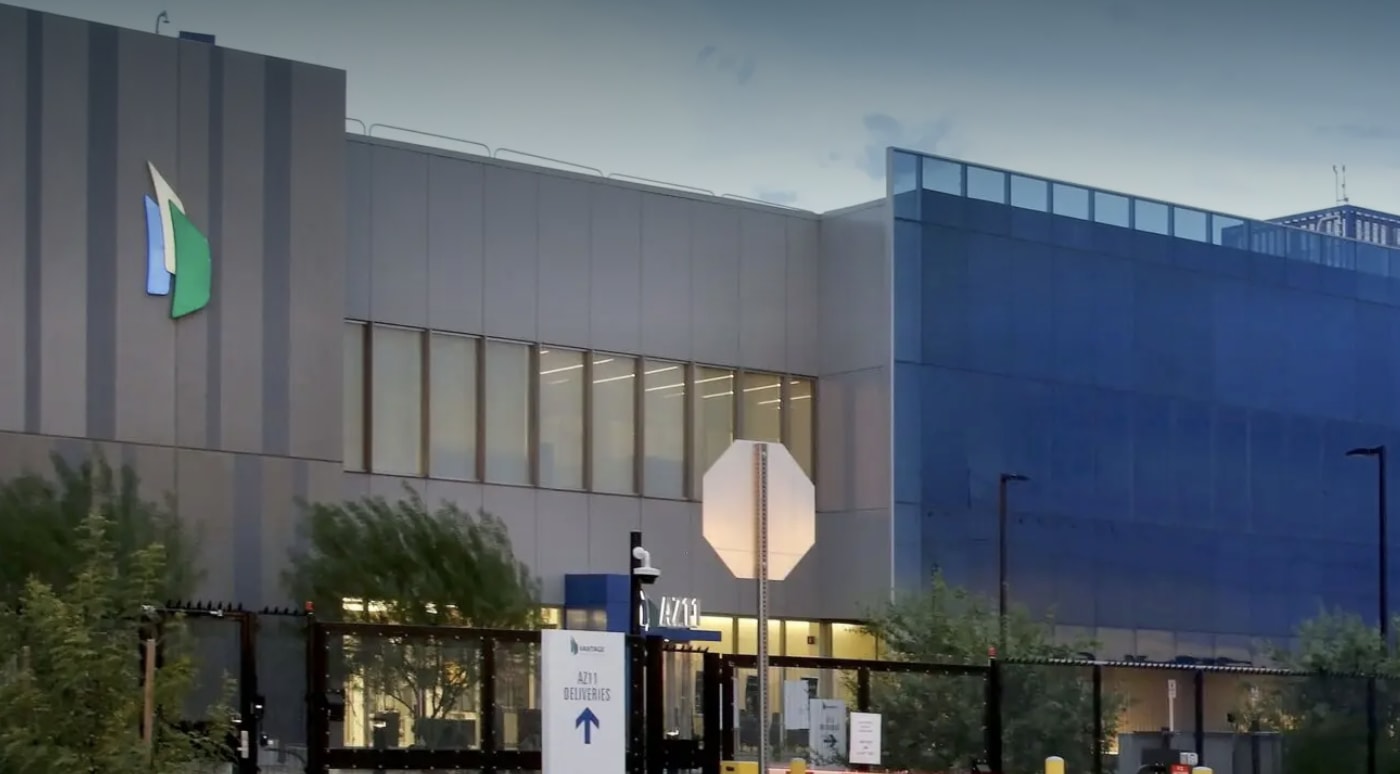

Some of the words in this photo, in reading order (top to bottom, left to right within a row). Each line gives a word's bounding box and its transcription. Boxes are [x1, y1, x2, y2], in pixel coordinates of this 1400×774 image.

[659, 596, 699, 627] AZ11
[577, 671, 598, 685] AZ11
[563, 687, 611, 701] DELIVERIES
